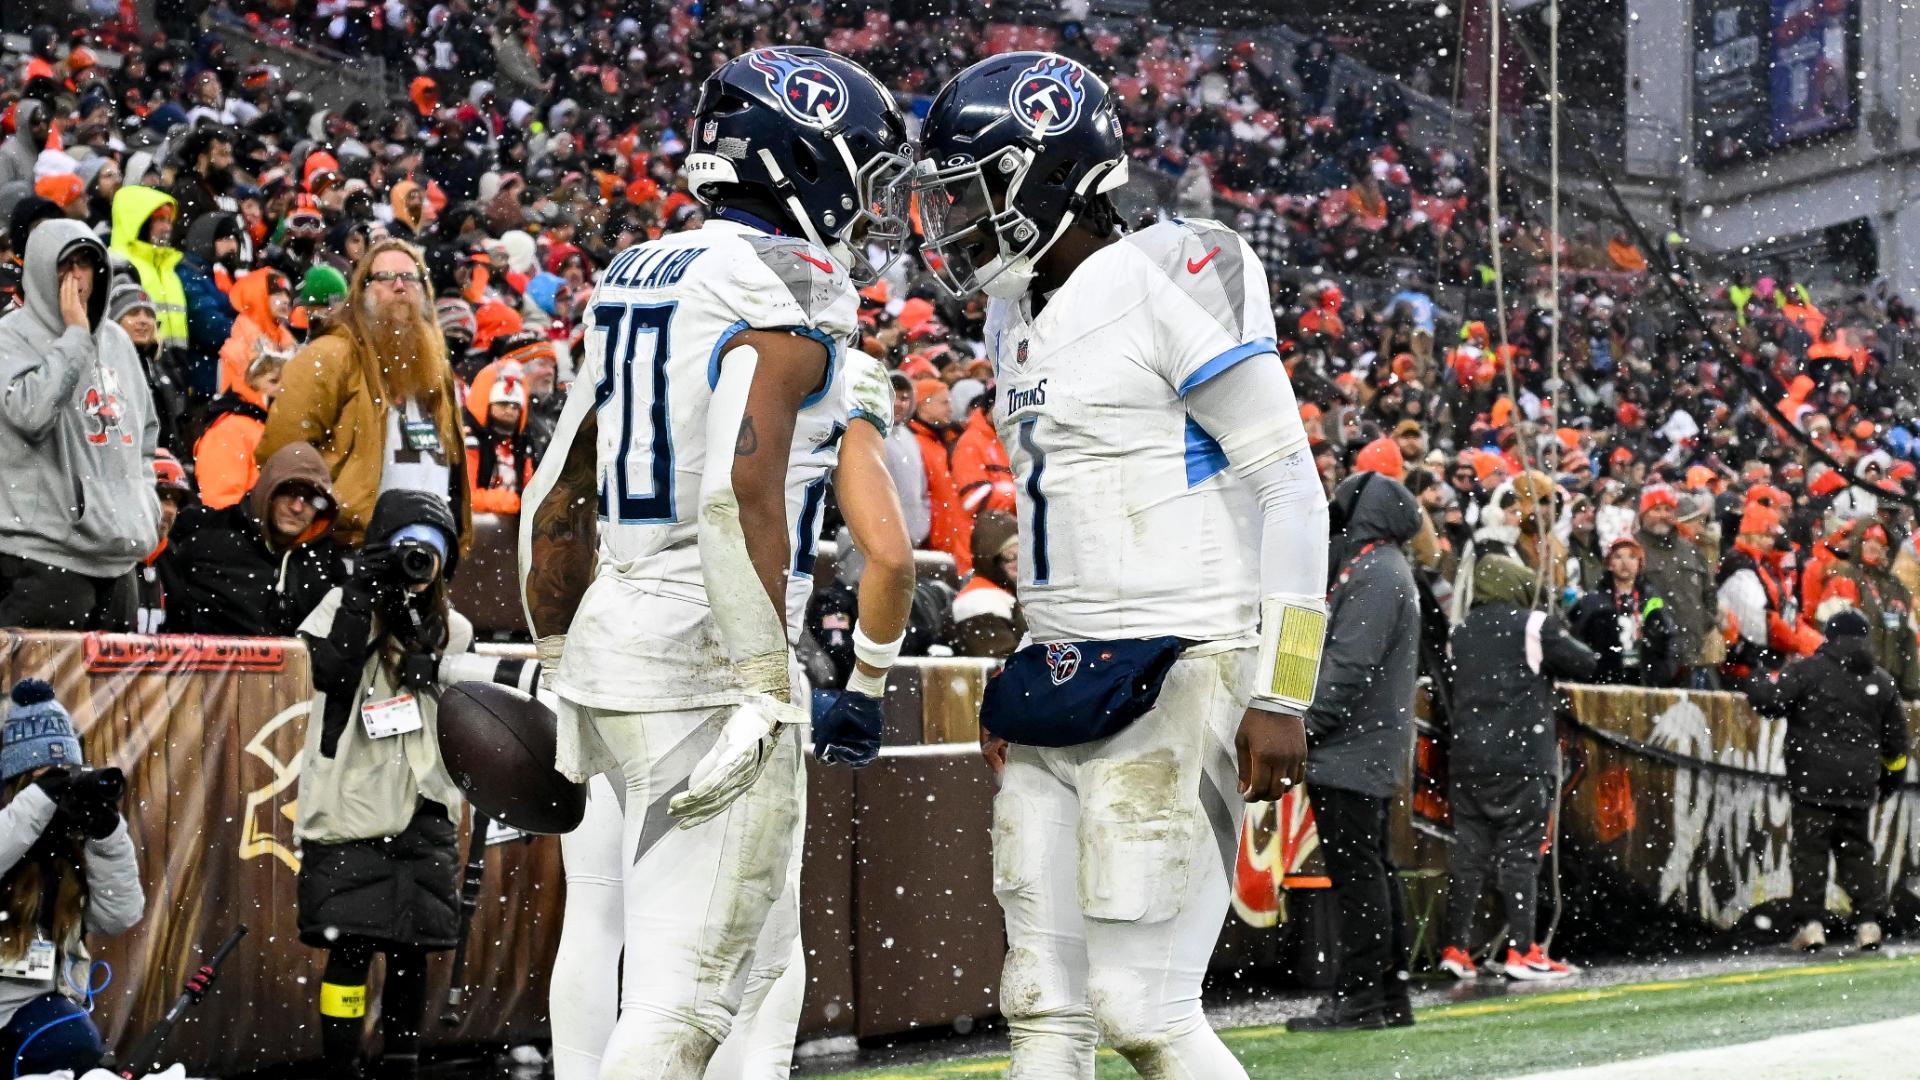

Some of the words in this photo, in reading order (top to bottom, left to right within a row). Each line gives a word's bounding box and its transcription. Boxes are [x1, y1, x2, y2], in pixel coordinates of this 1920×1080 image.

[604, 246, 711, 289] OLLARD
[1007, 378, 1048, 416] TITANS
[1018, 414, 1051, 585] 1
